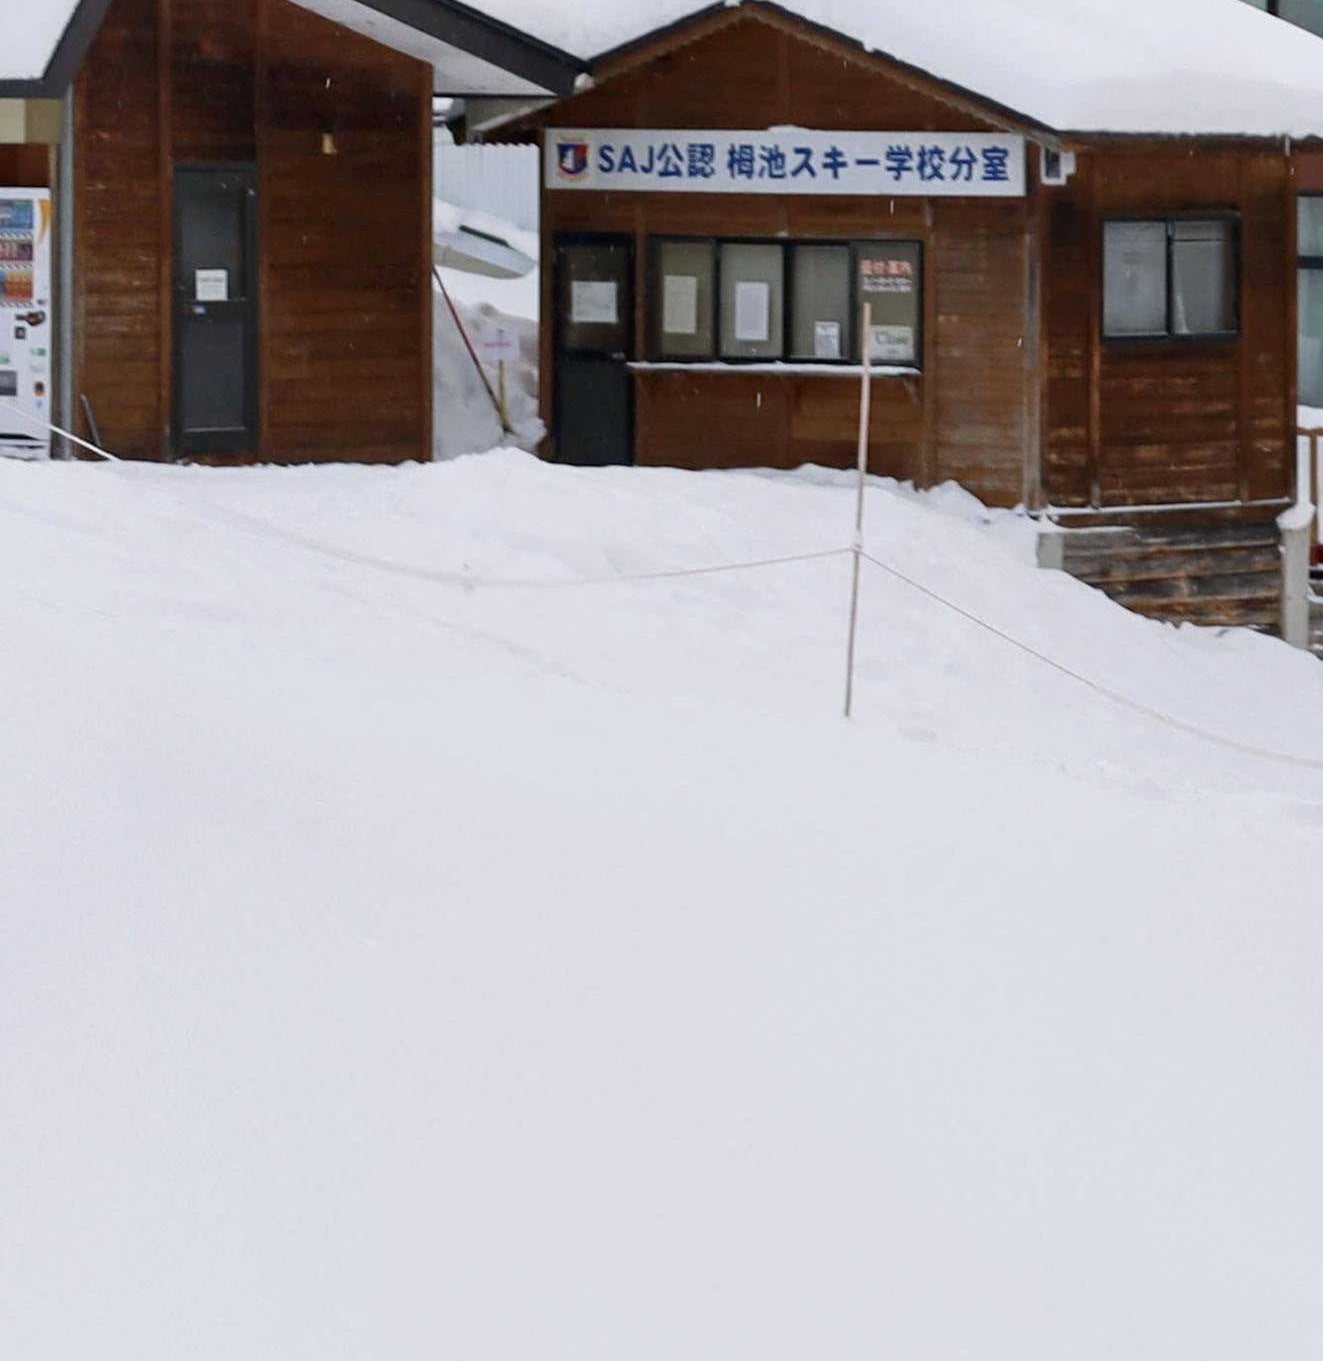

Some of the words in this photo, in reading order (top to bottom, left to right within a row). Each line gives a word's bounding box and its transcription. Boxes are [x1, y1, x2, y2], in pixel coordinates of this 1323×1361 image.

[598, 143, 716, 178] SAJ公認
[727, 144, 1010, 181] 栂池スキー学校分室
